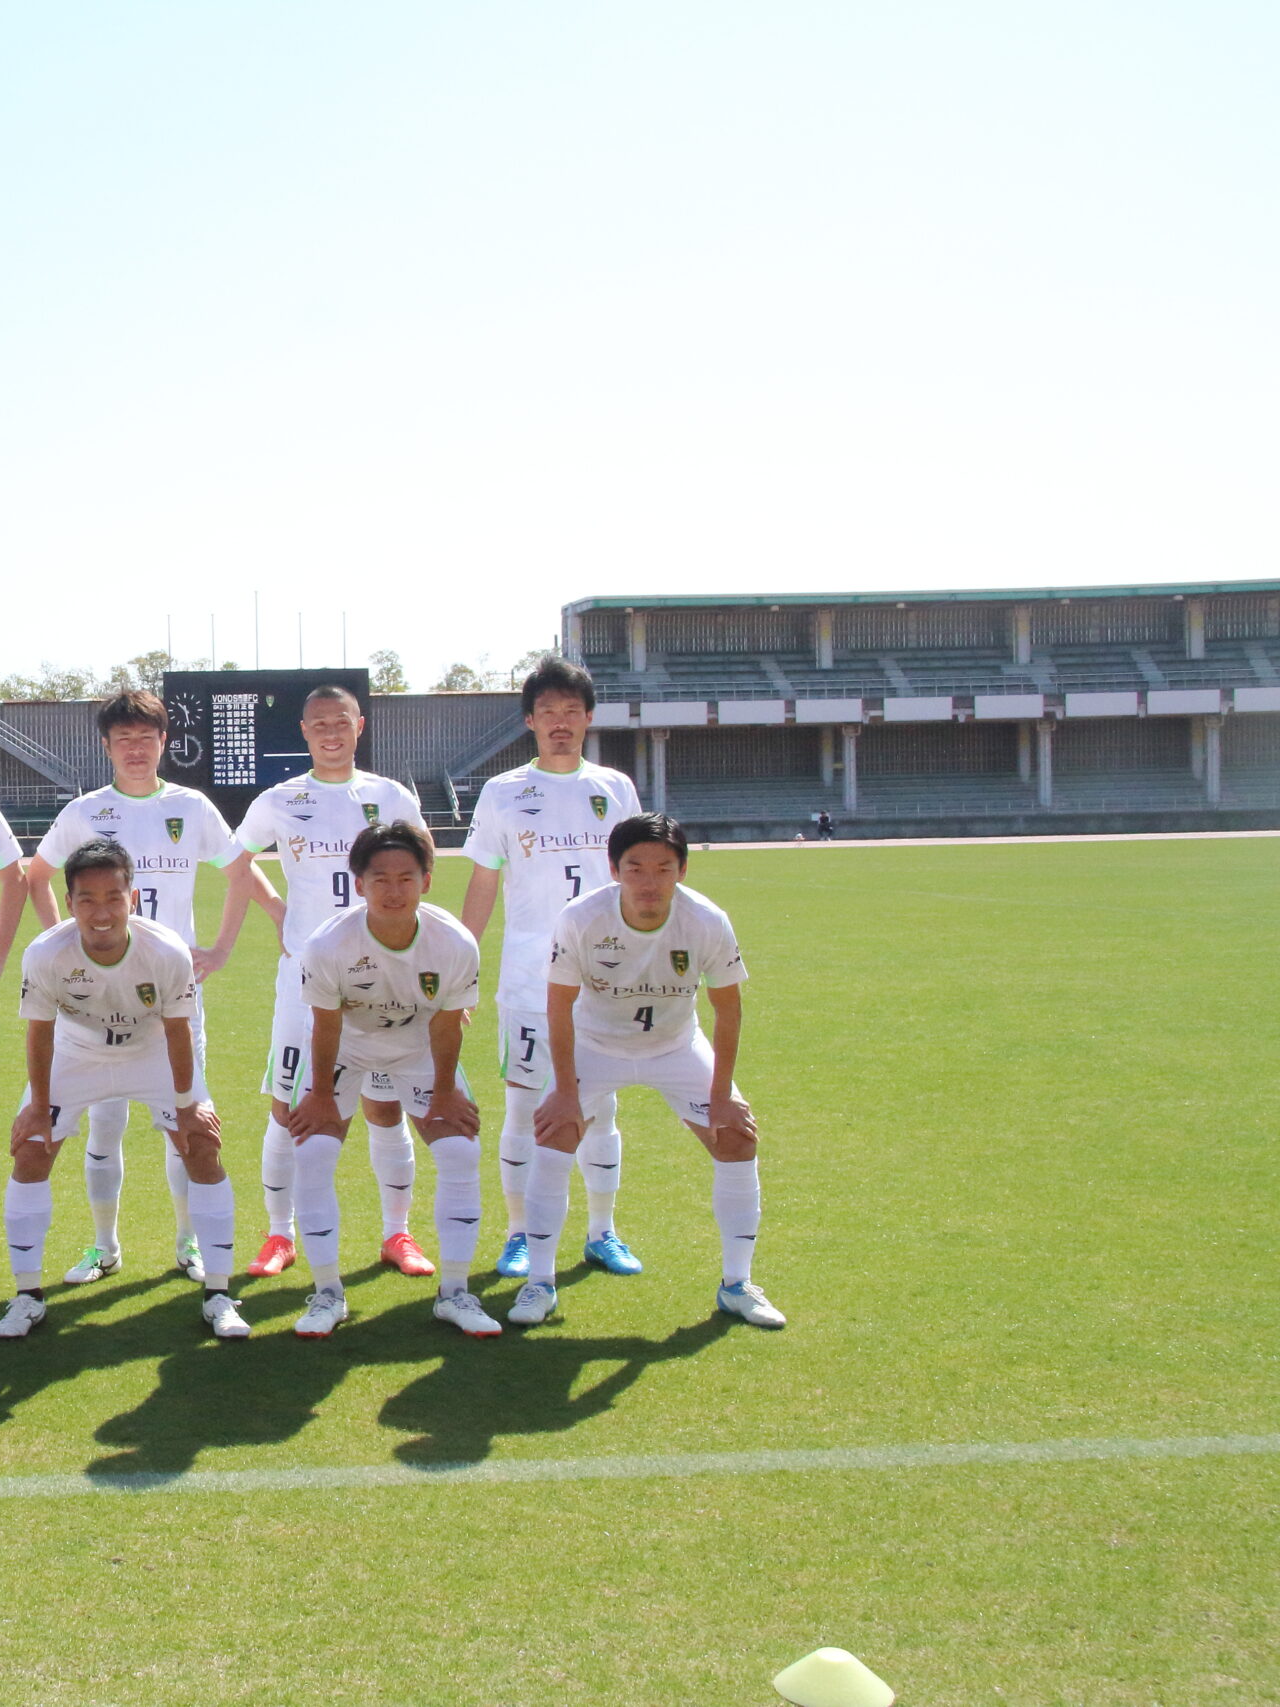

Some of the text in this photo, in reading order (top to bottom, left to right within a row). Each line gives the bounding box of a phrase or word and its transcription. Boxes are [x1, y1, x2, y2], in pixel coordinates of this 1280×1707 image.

[170, 740, 181, 748] 45
[310, 839, 354, 853] Pulc
[137, 855, 189, 869] lchra
[333, 871, 350, 907] 9
[564, 864, 582, 902] 5
[633, 1006, 654, 1032] 4
[520, 1025, 536, 1062] 5
[281, 1045, 300, 1081] 9
